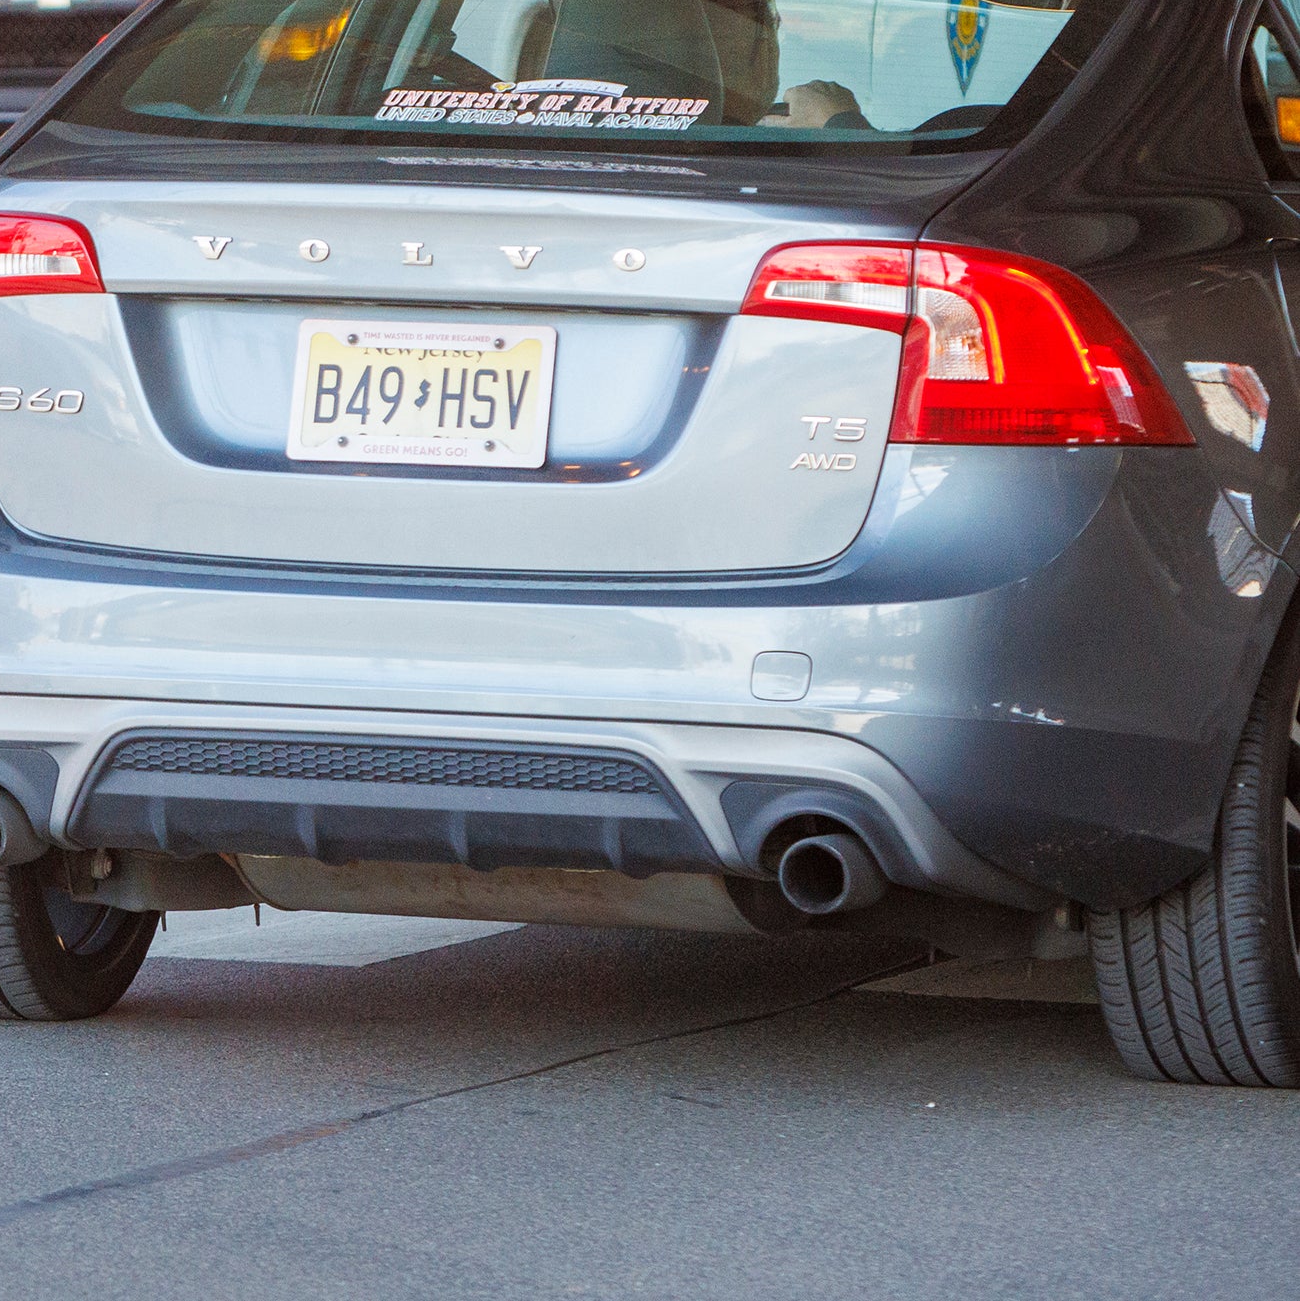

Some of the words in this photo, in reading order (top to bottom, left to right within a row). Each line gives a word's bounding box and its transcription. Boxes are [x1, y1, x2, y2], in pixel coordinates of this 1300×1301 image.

[384, 89, 539, 111] UNIVERSITY
[539, 94, 574, 112] OF
[574, 95, 709, 116] HARTFORD
[374, 106, 446, 122] UNITED
[447, 108, 518, 125] STATES
[532, 111, 594, 126] NAVAL
[596, 113, 698, 131] ACADEMY
[193, 236, 647, 273] VOLVO
[363, 331, 381, 339] TIME
[384, 332, 414, 341] WASTED
[417, 333, 423, 341] IS
[425, 333, 450, 342] NEVER
[451, 334, 492, 343] REGAINED
[313, 363, 405, 425] B49
[437, 367, 531, 430] HSV
[800, 415, 868, 442] T5
[362, 444, 399, 454] GREEN
[402, 445, 441, 456] MEANS
[445, 446, 468, 457] GO!
[789, 452, 857, 471] AWD
